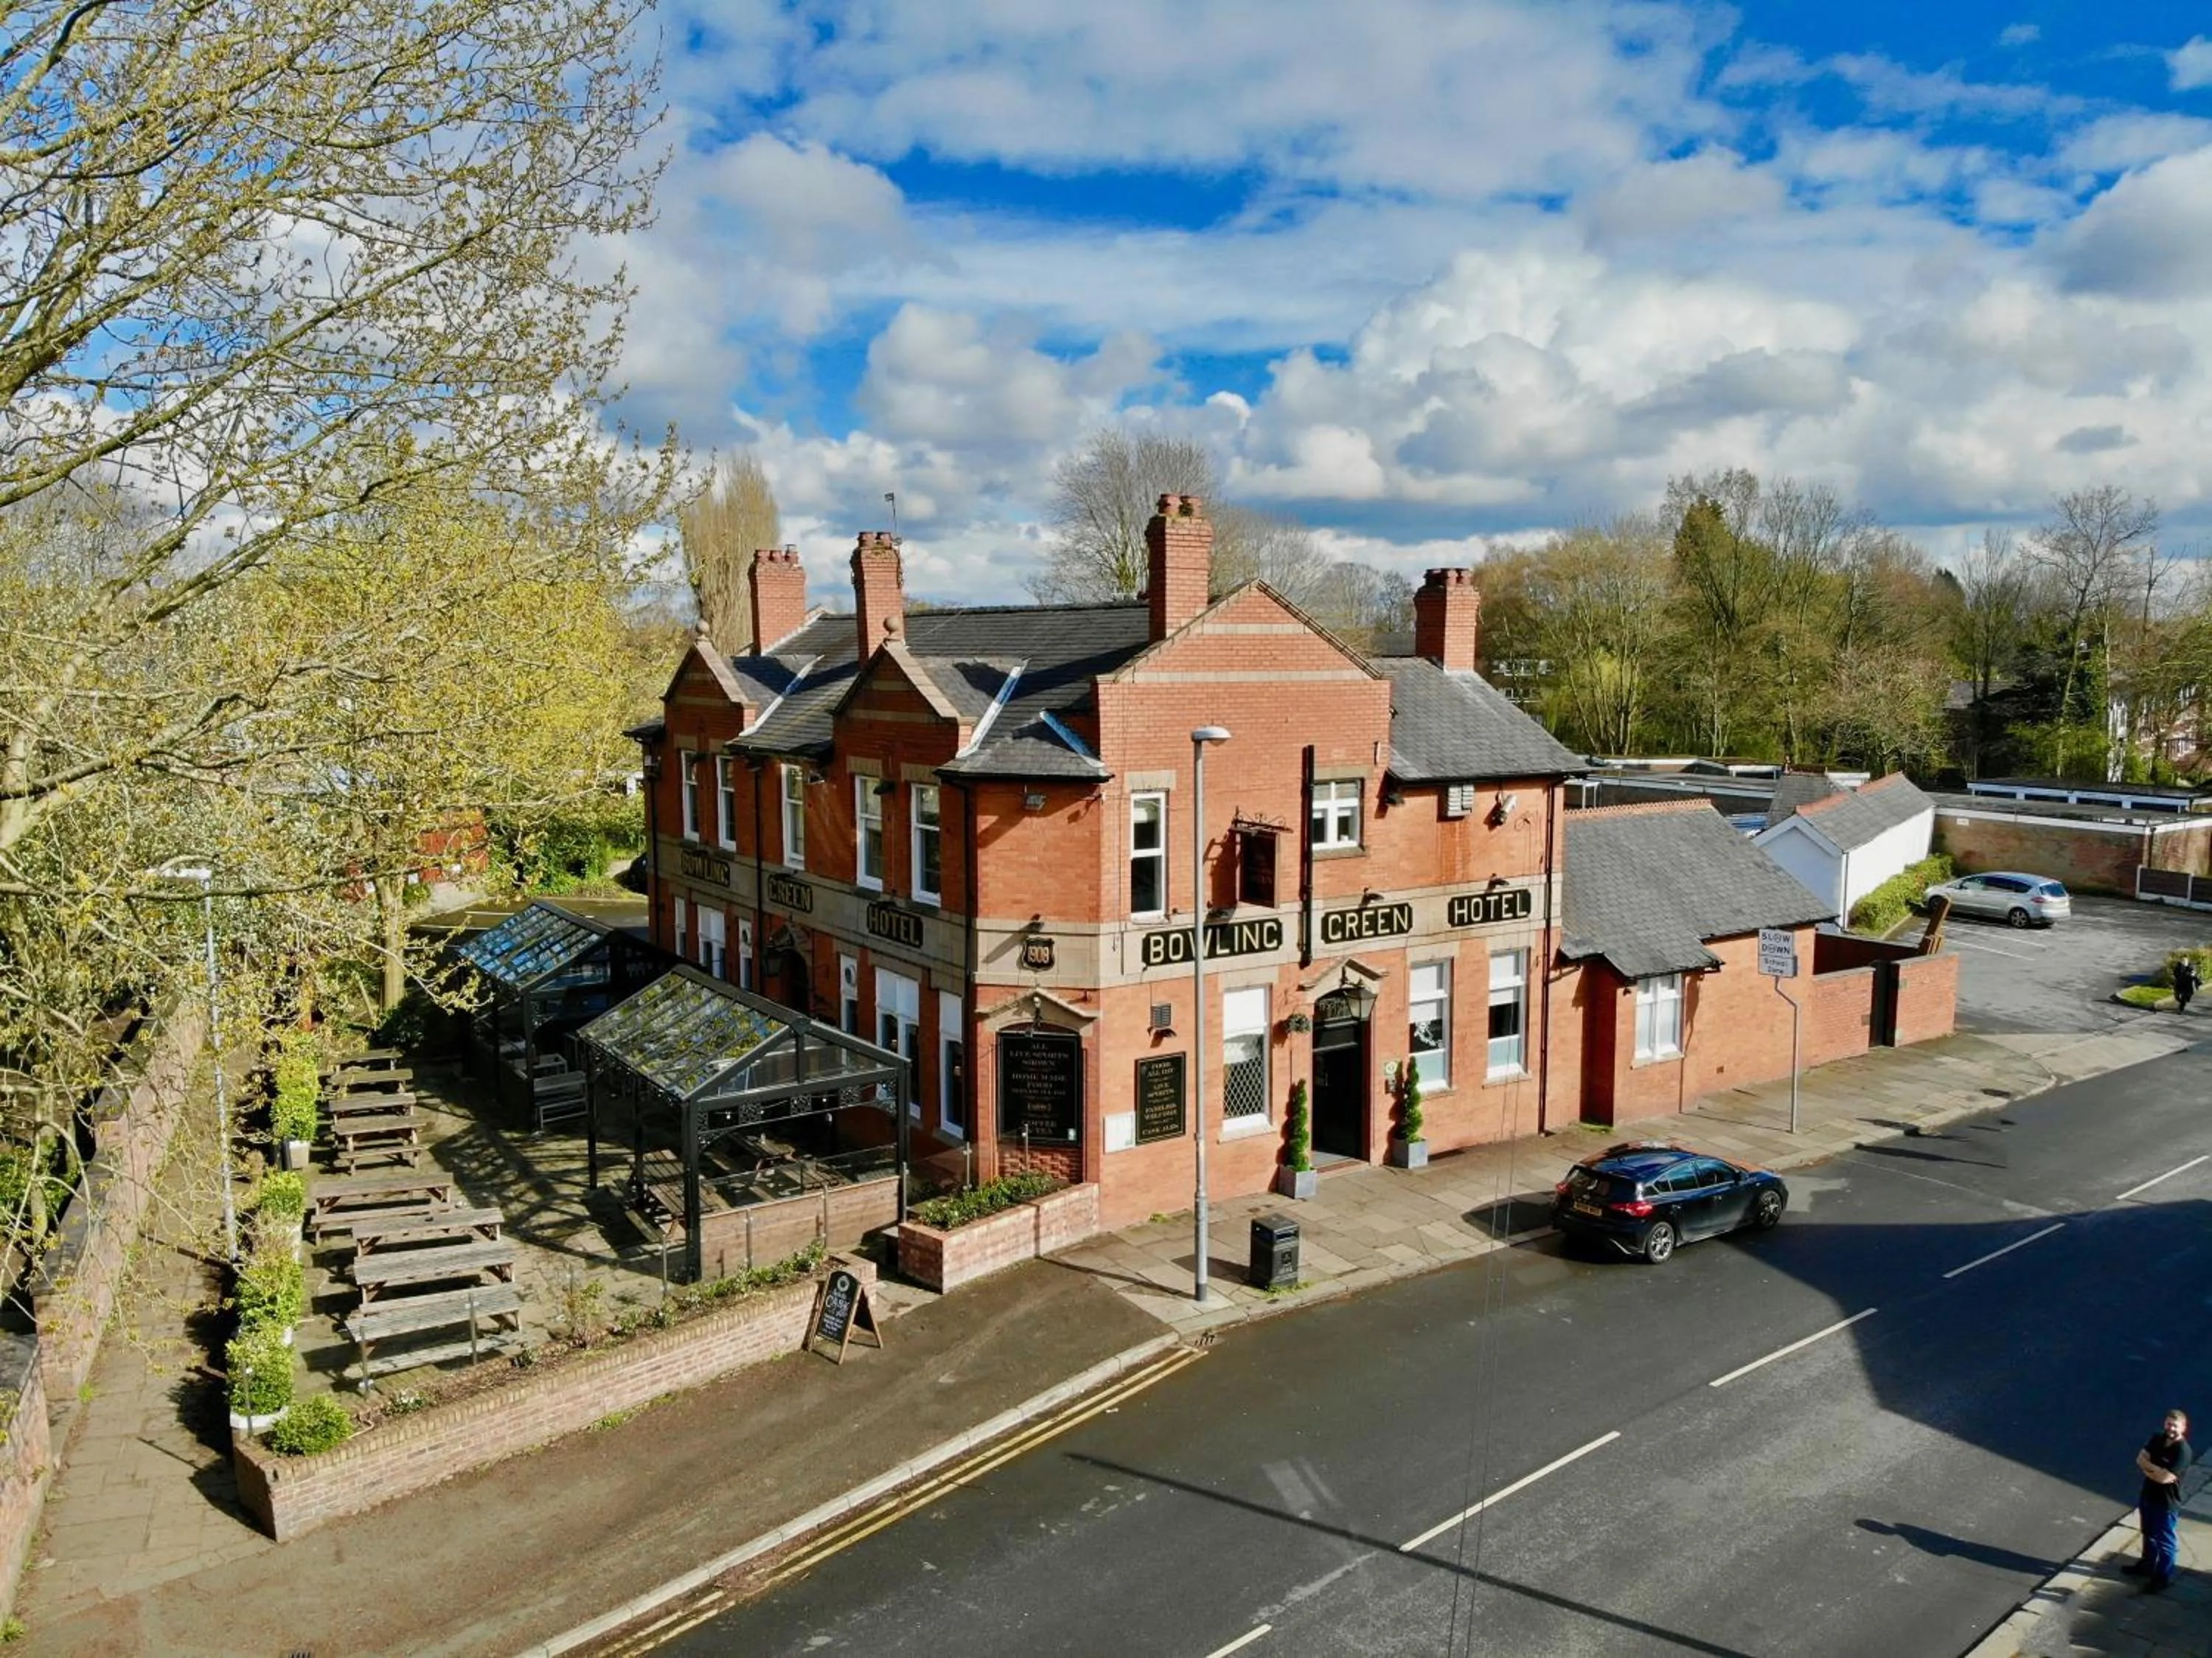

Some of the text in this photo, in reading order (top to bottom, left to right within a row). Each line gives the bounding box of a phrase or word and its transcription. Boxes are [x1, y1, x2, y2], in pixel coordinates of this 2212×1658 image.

[769, 877, 811, 912] GREEN
[869, 906, 919, 945] HOTEL
[1150, 892, 1528, 965] BOWLING GREEN HOTEL
[1761, 932, 1790, 943] SLOW
